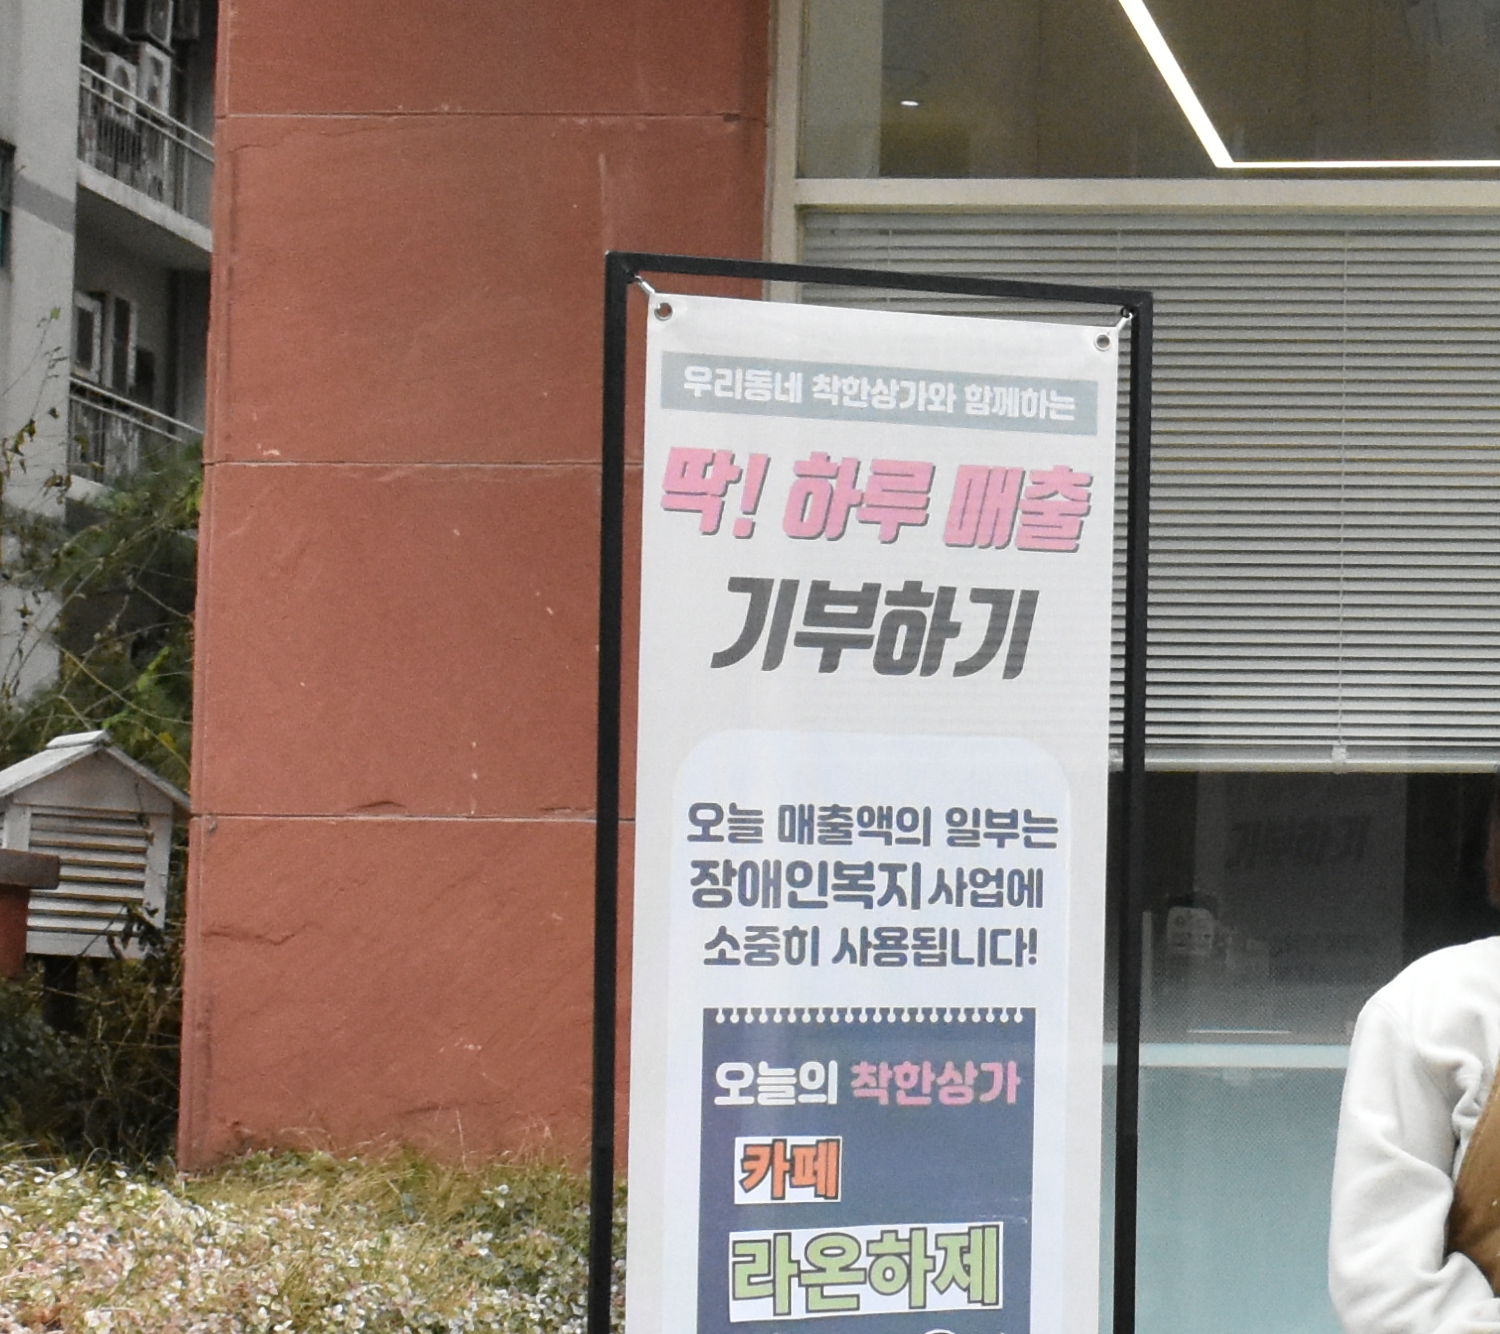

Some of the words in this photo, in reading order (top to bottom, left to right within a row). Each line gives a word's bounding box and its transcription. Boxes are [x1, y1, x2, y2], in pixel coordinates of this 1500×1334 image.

[683, 366, 802, 404] 우리동네
[812, 373, 957, 415] 착한상가와
[964, 381, 1076, 422] 함께하는
[661, 446, 769, 539] 딱!
[782, 452, 936, 544] 하루
[942, 464, 1093, 553] 매출
[710, 576, 1040, 681] 기부하기
[687, 802, 765, 845] 오늘
[776, 804, 932, 848] 매출액의
[945, 807, 1059, 850] 일부는
[689, 859, 922, 911] 장애인복지
[929, 867, 1044, 909] 사업에
[703, 925, 819, 967] 소중히
[831, 926, 1039, 968] 사용됩니다!
[714, 1061, 839, 1108] 오늘의
[851, 1059, 1021, 1106] 착한상가
[738, 1135, 842, 1201] 카페
[729, 1224, 1003, 1317] 라온하제
